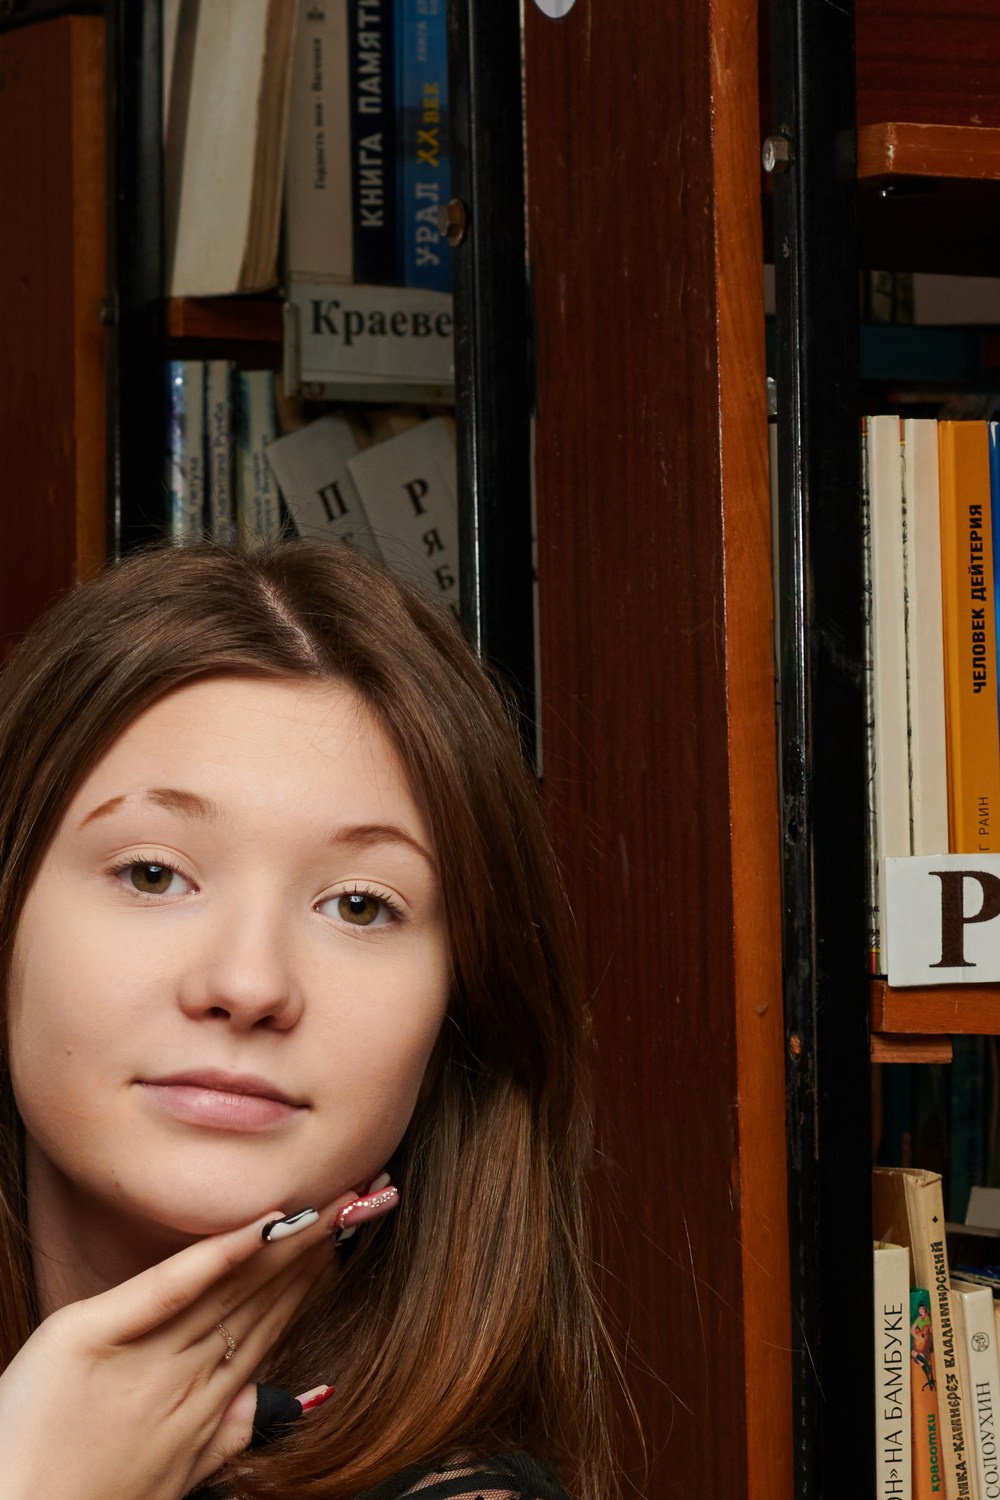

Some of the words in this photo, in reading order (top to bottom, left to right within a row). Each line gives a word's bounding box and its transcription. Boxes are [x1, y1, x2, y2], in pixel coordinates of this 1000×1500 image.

[357, 131, 385, 228] КНИГА
[413, 181, 441, 267] УРАЛ
[965, 503, 987, 602] ДЕЙТЕРИЯ
[970, 606, 988, 695] ЧЕЛОВЕК
[977, 795, 991, 836] РАИН
[883, 1302, 903, 1421] БАМБУКЕ
[884, 1429, 903, 1463] НА
[926, 1412, 941, 1493] красотки
[975, 1380, 1000, 1499] СОЛОУХИН
